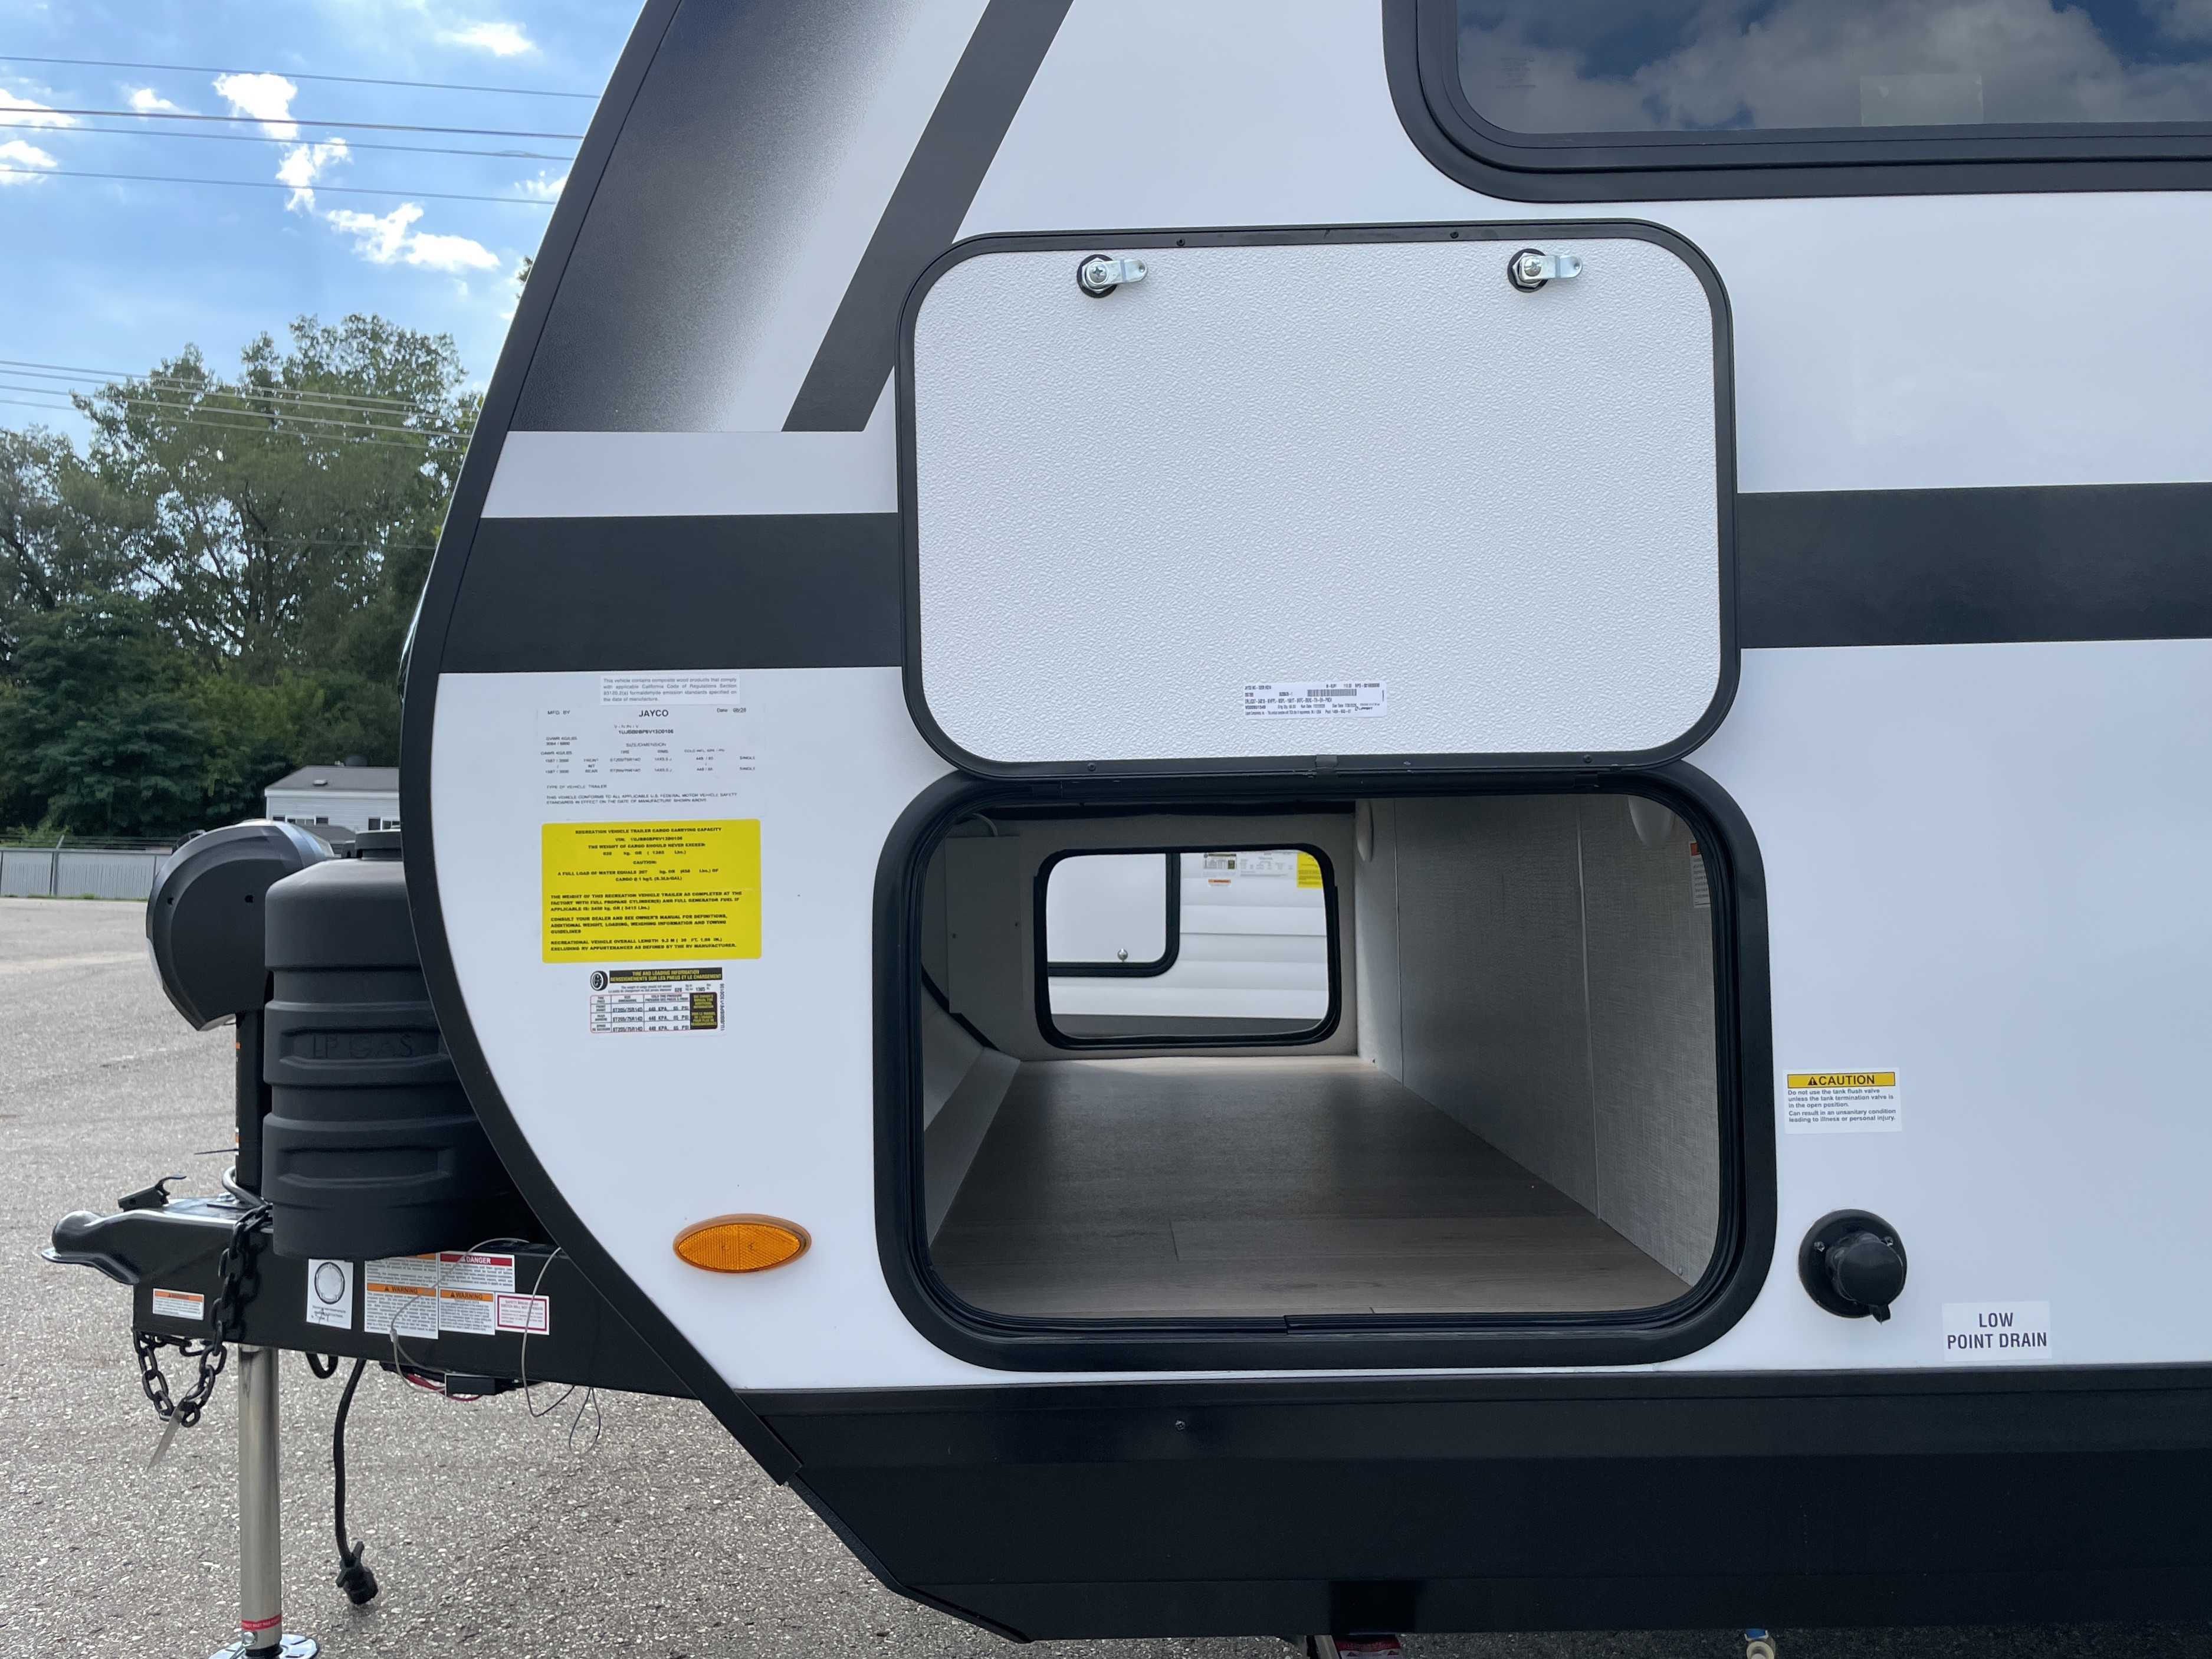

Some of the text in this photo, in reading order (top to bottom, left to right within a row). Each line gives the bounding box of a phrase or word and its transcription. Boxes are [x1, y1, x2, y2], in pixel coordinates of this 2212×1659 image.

[1819, 1075, 1875, 1086] CAUTION
[465, 1256, 491, 1264] DANGER
[392, 1285, 418, 1294] WARNING
[456, 1291, 483, 1300] WARNING
[1978, 1312, 2013, 1327] LOW
[1947, 1332, 2047, 1349] POINT DRAIN
